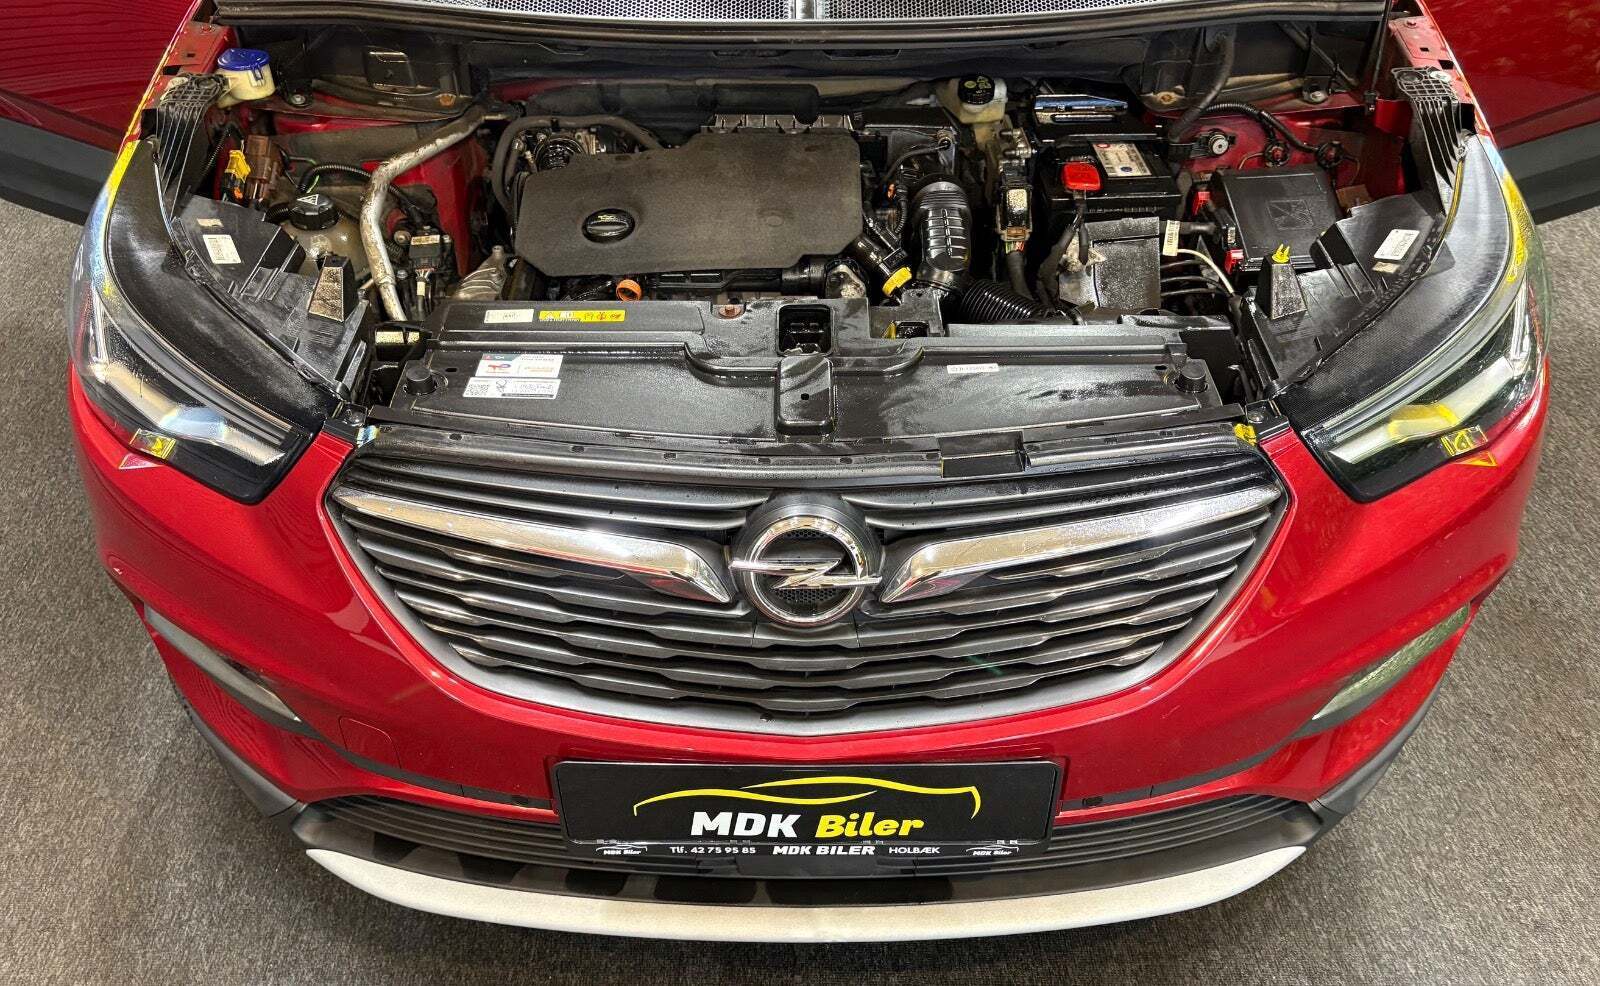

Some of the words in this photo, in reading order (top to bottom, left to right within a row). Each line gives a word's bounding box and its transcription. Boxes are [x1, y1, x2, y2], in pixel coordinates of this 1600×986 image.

[690, 811, 801, 838] MDK
[815, 811, 924, 838] Biler
[772, 845, 812, 855] MDK
[816, 845, 876, 855] BILER
[889, 846, 941, 854] HOLBÆK
